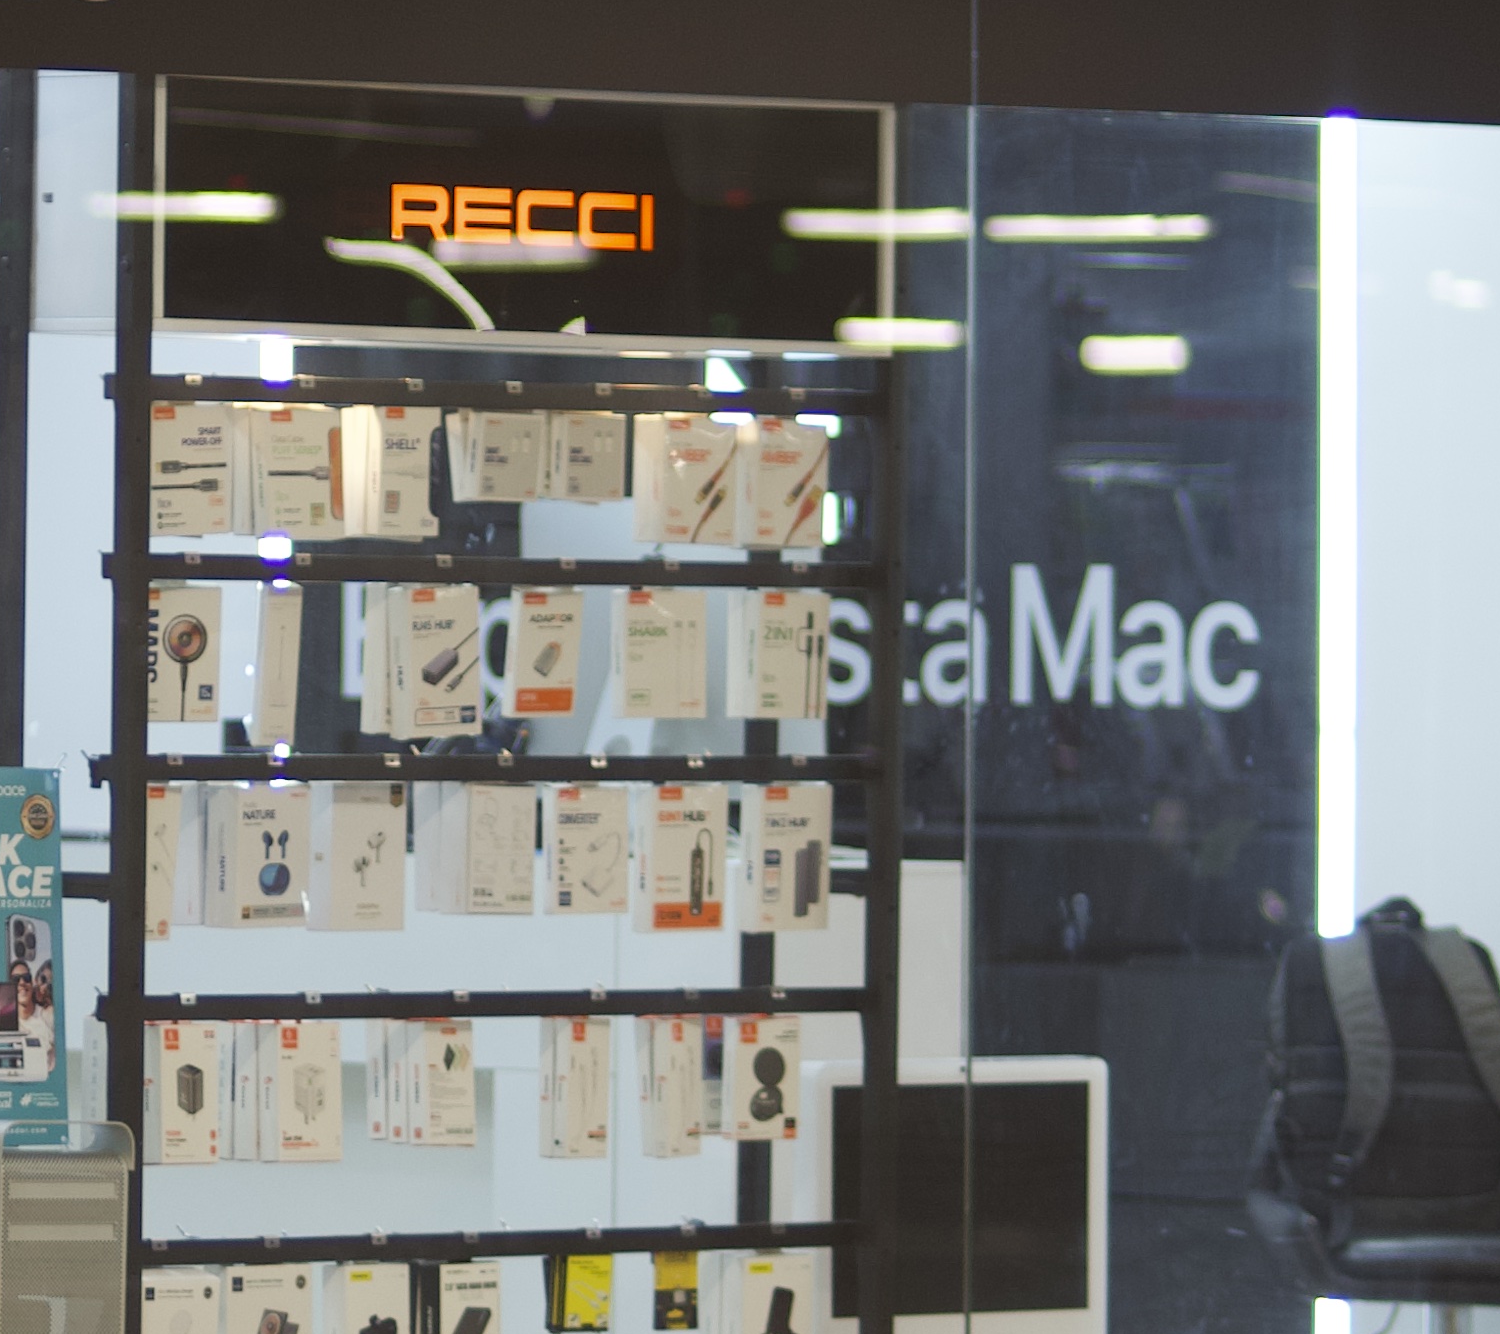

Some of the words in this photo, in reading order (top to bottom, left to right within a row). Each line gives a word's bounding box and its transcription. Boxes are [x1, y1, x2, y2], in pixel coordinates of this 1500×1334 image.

[390, 183, 654, 252] RECCI
[1010, 563, 1260, 711] Mac
[243, 809, 276, 820] NATURE
